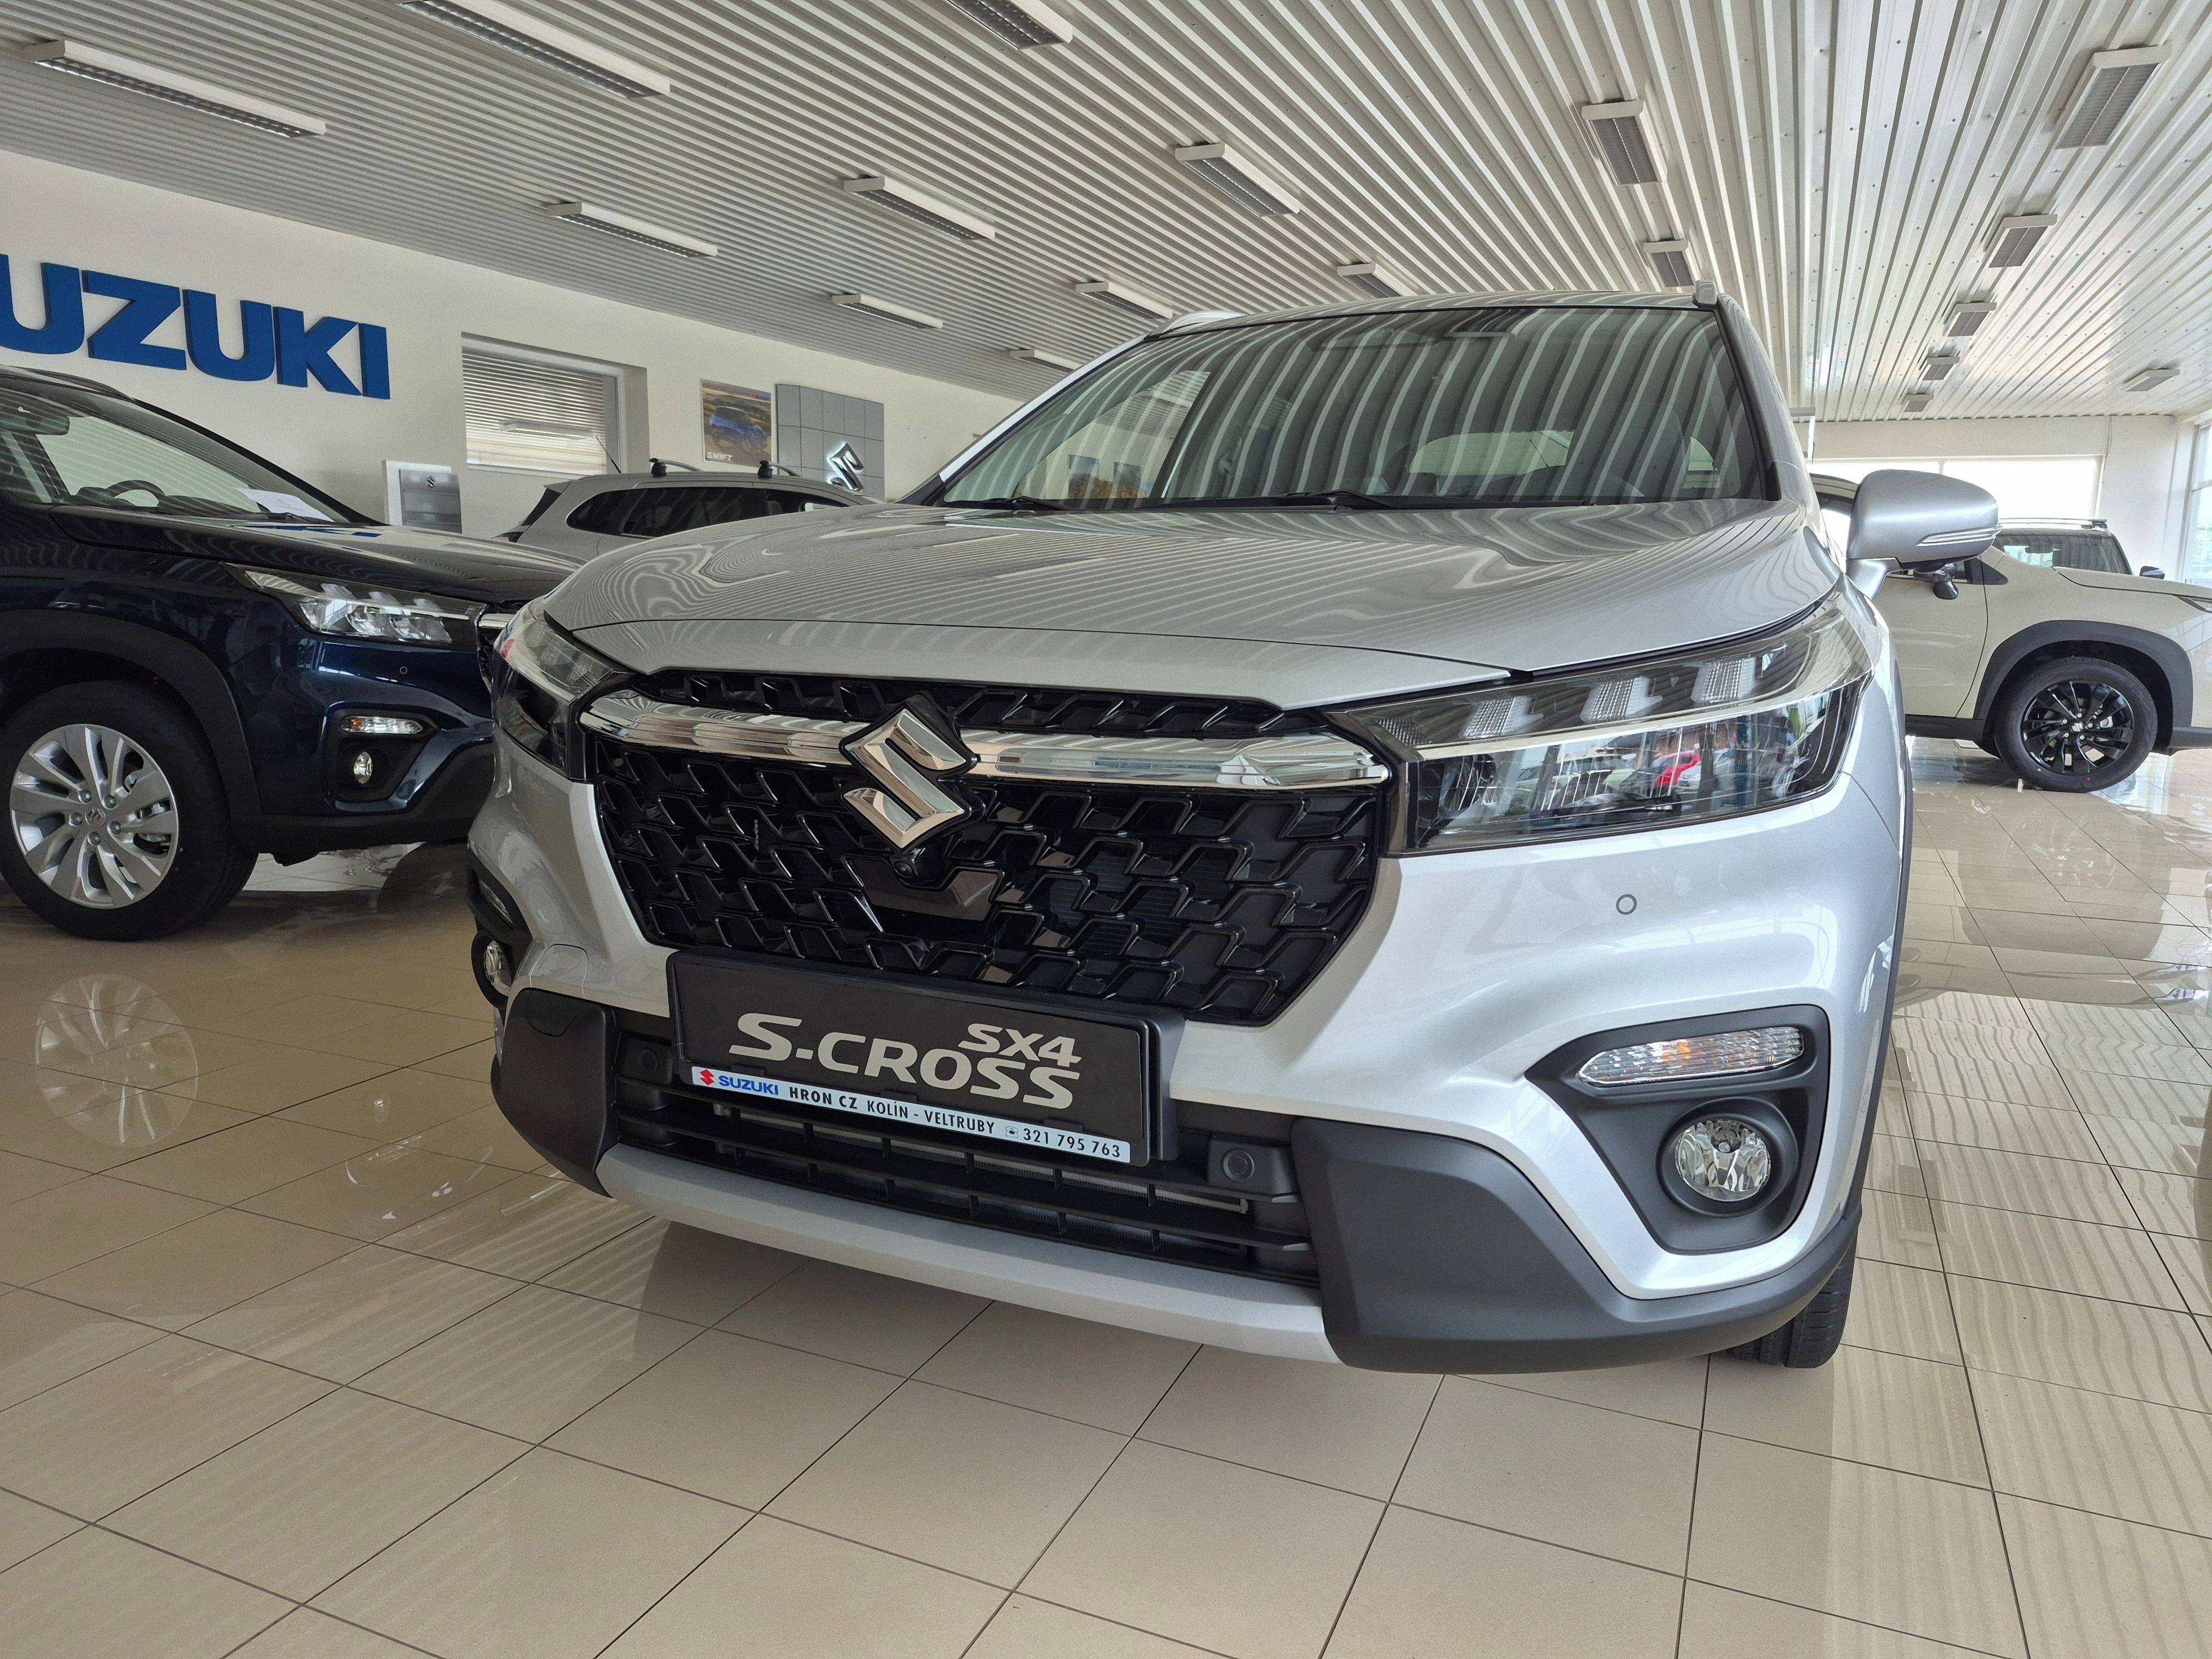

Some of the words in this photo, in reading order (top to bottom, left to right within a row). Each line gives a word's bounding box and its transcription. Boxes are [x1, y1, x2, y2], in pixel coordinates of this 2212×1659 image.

[0, 254, 390, 400] UZUKI
[706, 452, 733, 461] SWIFT
[729, 1013, 1080, 1109] S-CROSS
[958, 1023, 1082, 1067] SX4
[718, 1075, 779, 1096] SUZUKI
[789, 1086, 832, 1105] HRON
[839, 1095, 858, 1110] CZ
[867, 1100, 908, 1119] KOLÍN
[924, 1110, 995, 1134] VELTRUBY
[1023, 1128, 1049, 1144] 321
[1057, 1134, 1085, 1151] 795
[1092, 1140, 1120, 1157] 763
